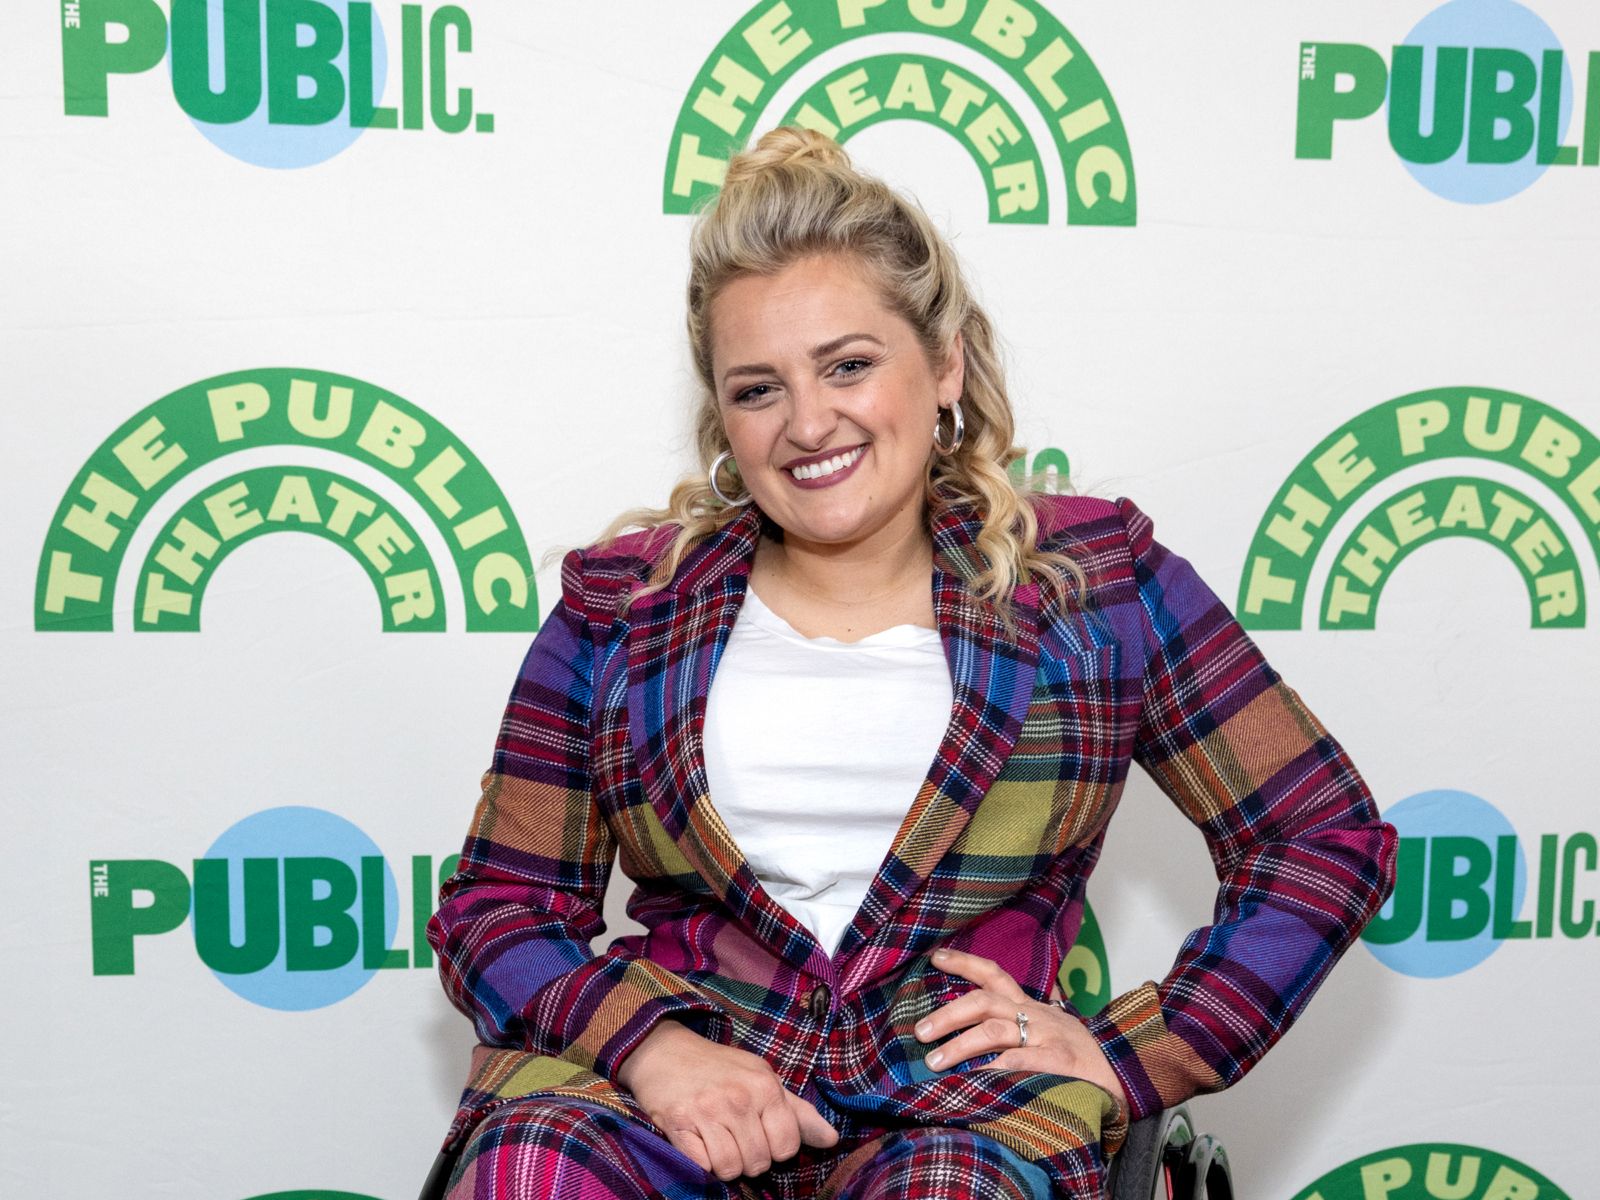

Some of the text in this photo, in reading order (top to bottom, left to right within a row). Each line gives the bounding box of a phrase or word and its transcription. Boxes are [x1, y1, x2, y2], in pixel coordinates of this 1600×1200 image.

[60, 0, 494, 133] PUBLIC.
[64, 0, 80, 29] HE
[1301, 45, 1317, 81] THE
[672, 0, 813, 198] THE
[795, 63, 1040, 218] EATER
[1295, 41, 1600, 167] PUBLI
[44, 378, 529, 615] THE PUBLIC
[142, 475, 436, 626] THEATER
[1244, 396, 1600, 615] THE PUBL
[1326, 484, 1579, 623] THEATER
[89, 853, 462, 976] PUBLI
[93, 863, 109, 898] THE
[1360, 832, 1600, 945] UBLIC
